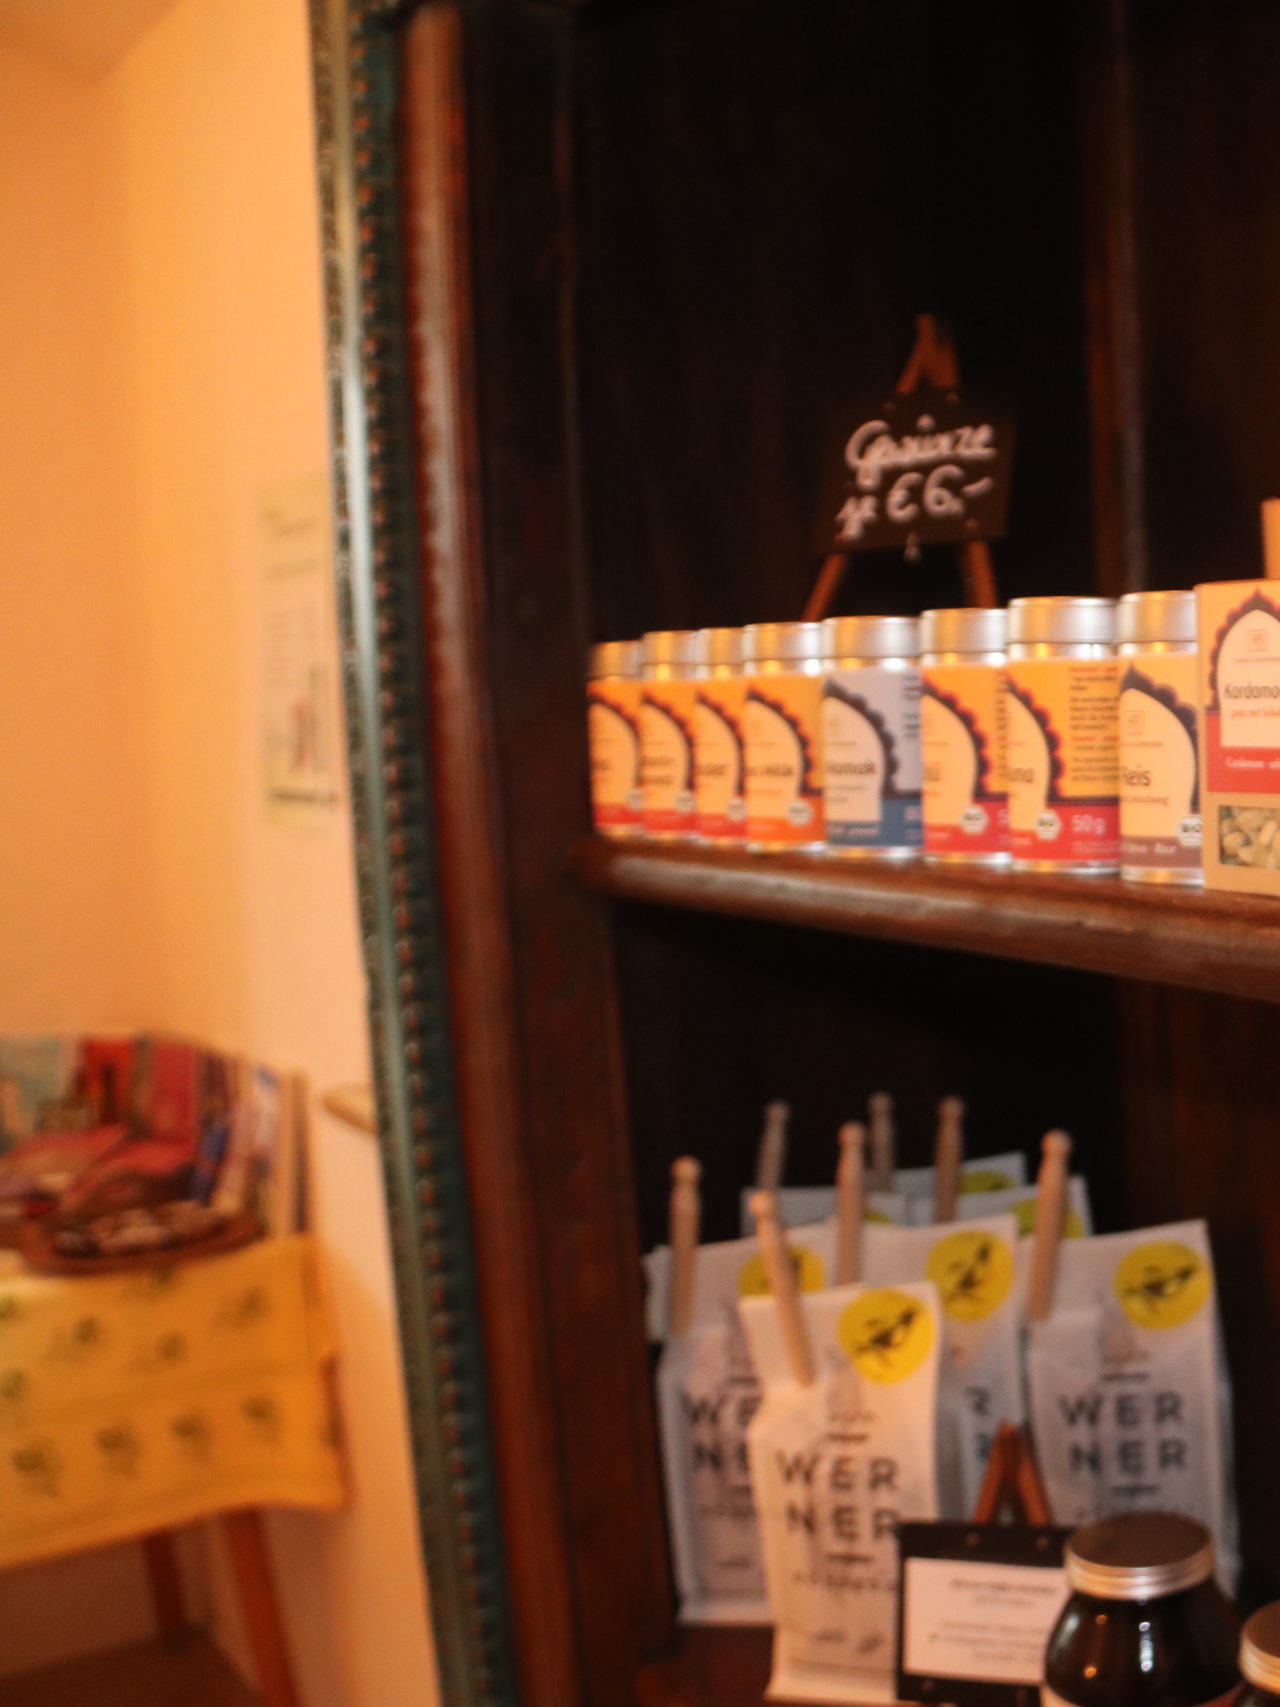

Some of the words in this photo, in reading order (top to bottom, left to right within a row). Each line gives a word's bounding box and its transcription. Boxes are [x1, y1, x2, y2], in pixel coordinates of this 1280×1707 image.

[1058, 1390, 1183, 1428] WER
[776, 1449, 898, 1492] WER
[1069, 1437, 1187, 1475] NER
[786, 1505, 899, 1542] NER
